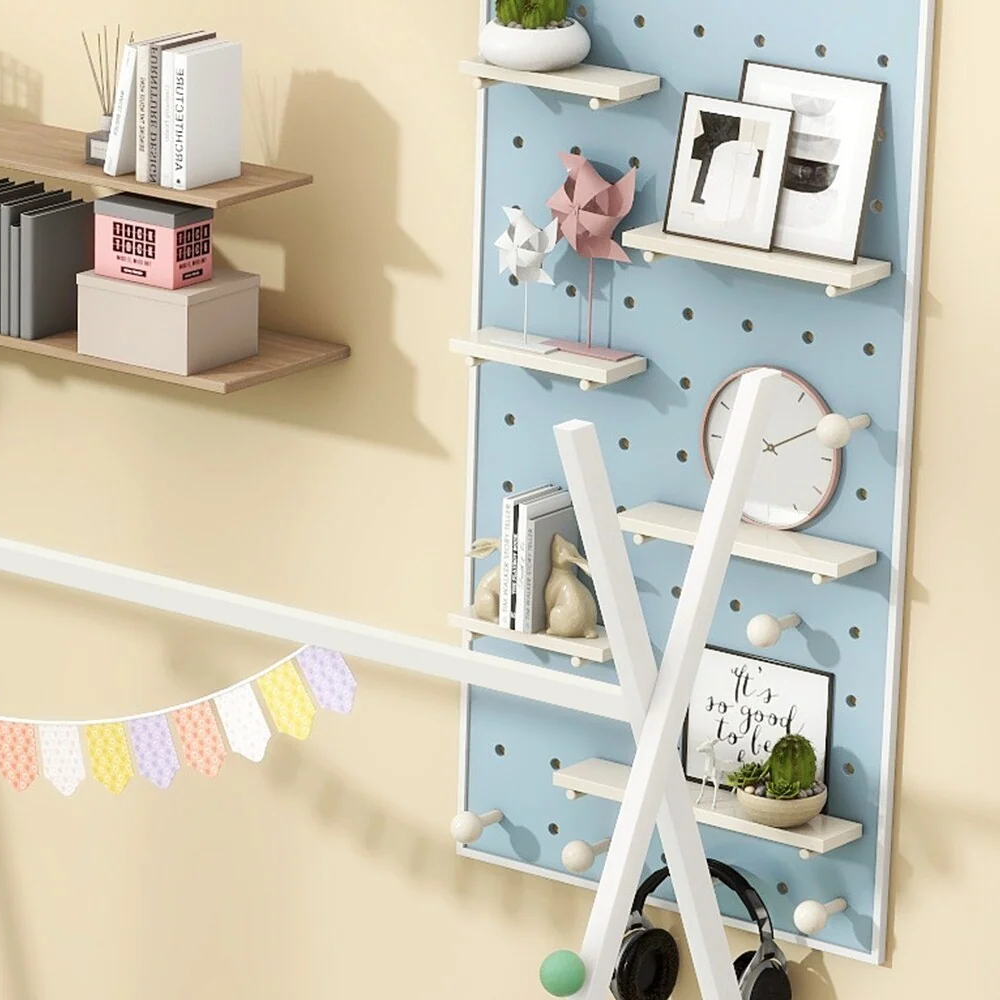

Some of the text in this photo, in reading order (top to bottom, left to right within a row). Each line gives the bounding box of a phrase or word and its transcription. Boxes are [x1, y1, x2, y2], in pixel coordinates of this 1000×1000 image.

[113, 238, 155, 259] TOCK
[731, 664, 779, 703] It's
[706, 696, 804, 735] so good
[714, 716, 773, 756] to be
